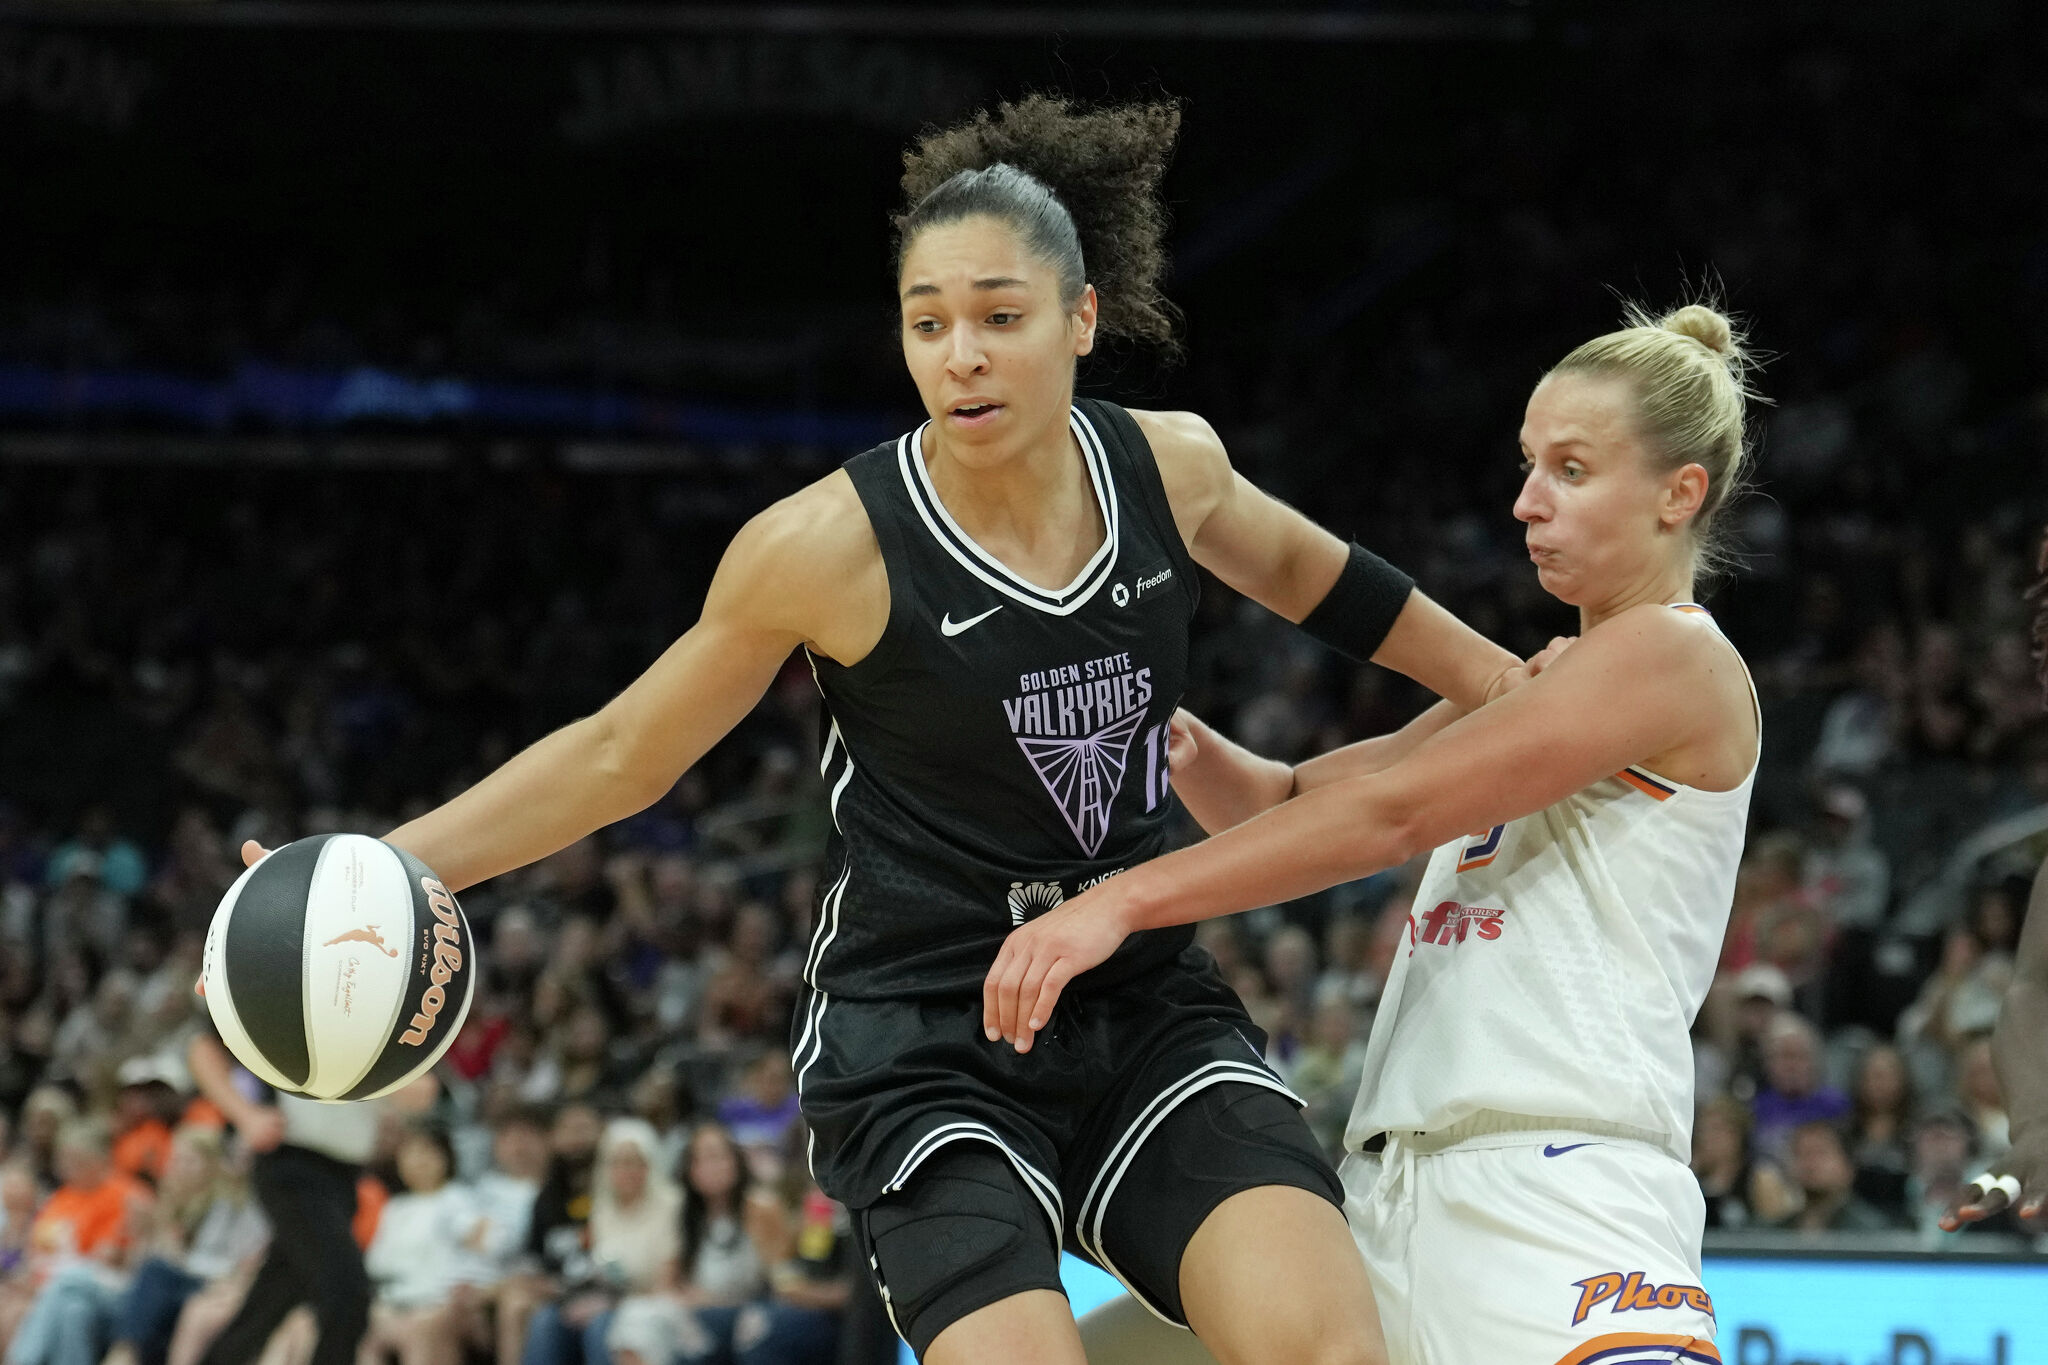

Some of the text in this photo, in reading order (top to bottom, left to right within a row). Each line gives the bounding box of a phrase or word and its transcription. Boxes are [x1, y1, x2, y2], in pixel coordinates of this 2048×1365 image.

[1136, 568, 1172, 599] freedom
[1020, 652, 1132, 693] GOLDEN STATE
[1002, 667, 1153, 736] VALKYRIES
[398, 876, 462, 1047] Wilson
[420, 953, 428, 975] NXT
[1571, 1271, 1717, 1329] Phoe
